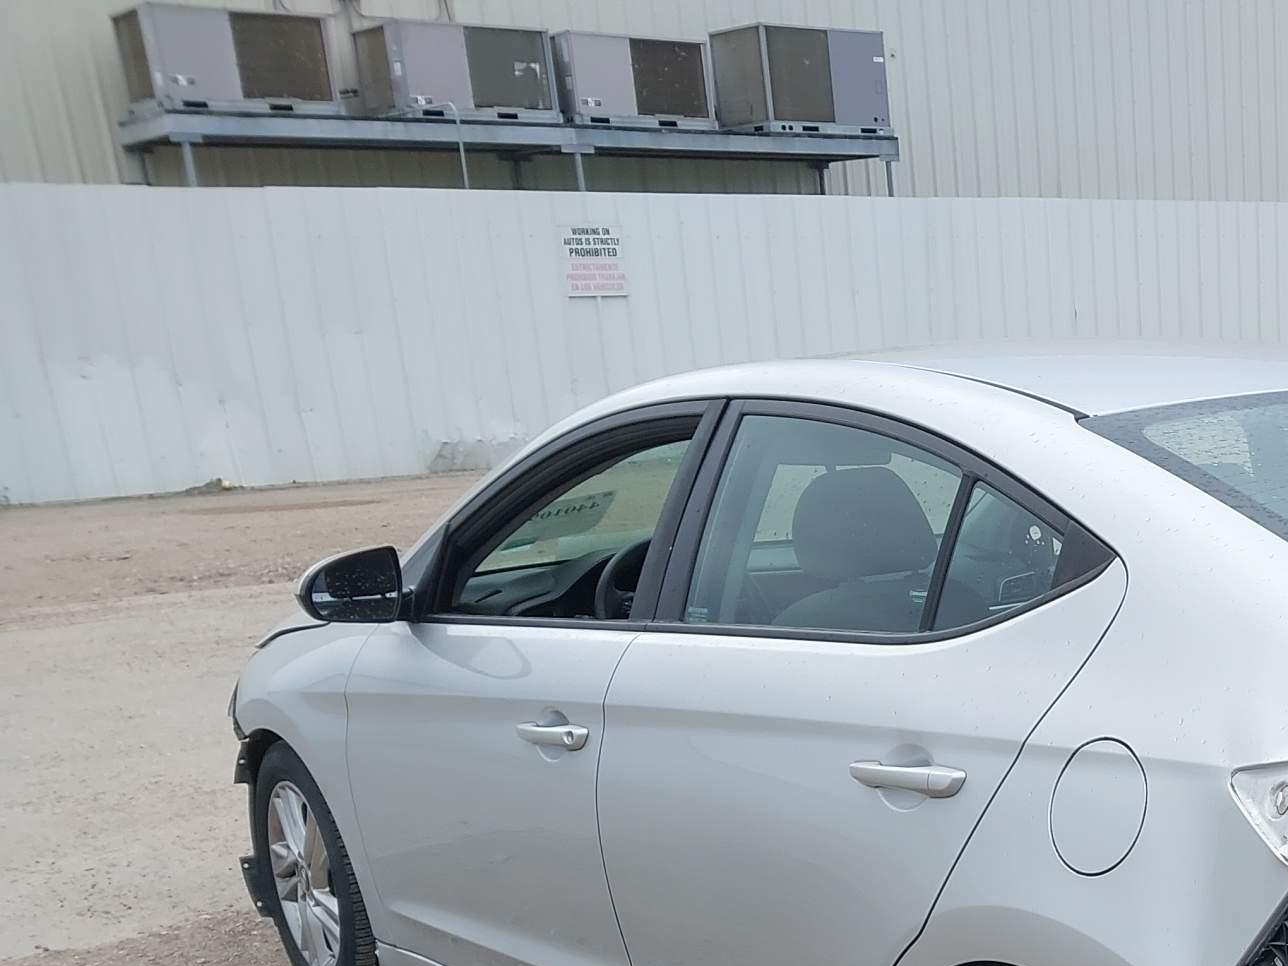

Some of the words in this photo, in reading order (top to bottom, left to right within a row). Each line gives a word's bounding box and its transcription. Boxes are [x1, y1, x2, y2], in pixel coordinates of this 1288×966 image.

[571, 227, 600, 235] WORKING
[602, 227, 610, 235] ON
[563, 238, 583, 246] AUTOS
[585, 238, 591, 246] IS
[592, 238, 620, 246] STRICTLY
[568, 247, 618, 257] PROHIBITED
